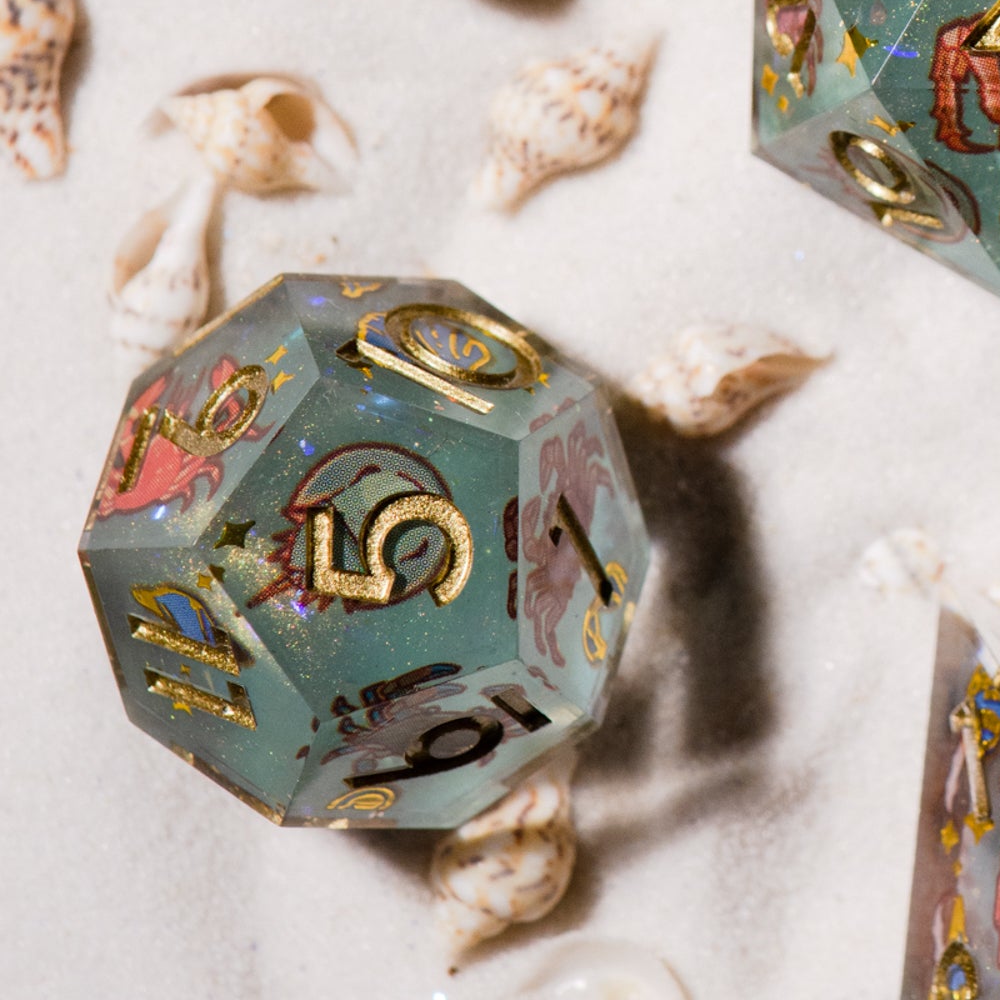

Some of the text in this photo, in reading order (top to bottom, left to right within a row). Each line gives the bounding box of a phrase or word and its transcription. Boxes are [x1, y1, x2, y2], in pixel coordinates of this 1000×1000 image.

[336, 302, 544, 415] 10
[305, 491, 474, 608] 5
[128, 612, 256, 731] 11
